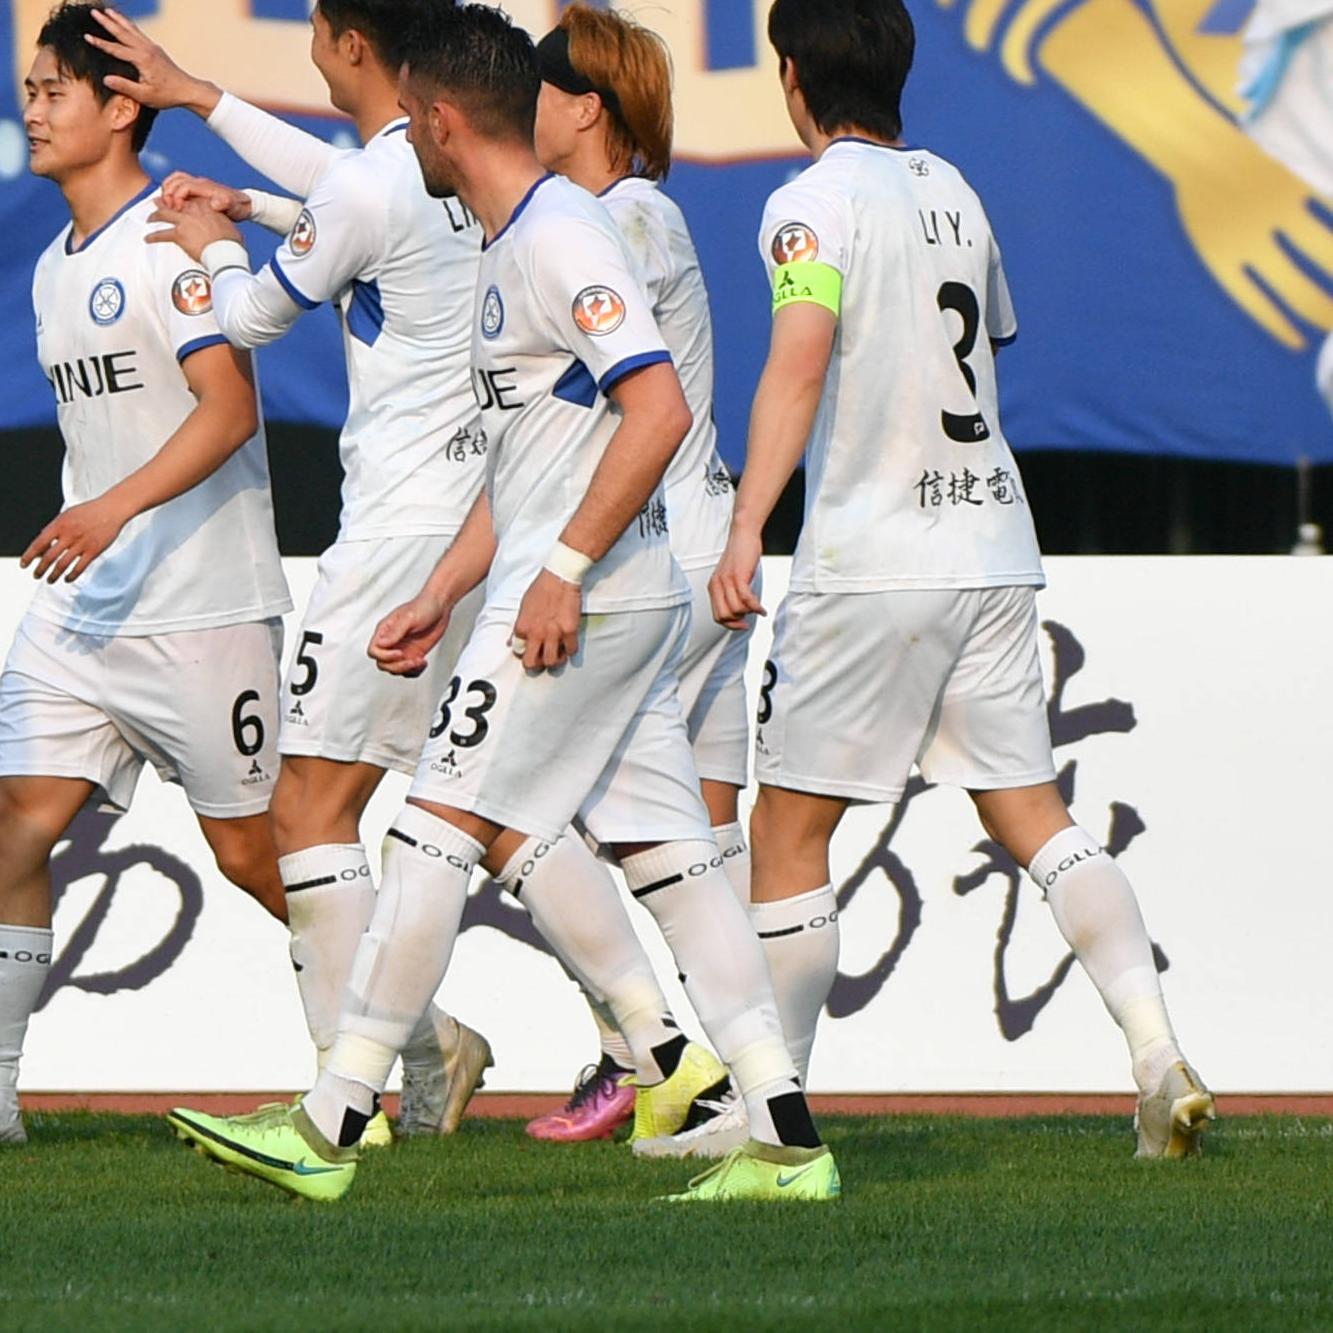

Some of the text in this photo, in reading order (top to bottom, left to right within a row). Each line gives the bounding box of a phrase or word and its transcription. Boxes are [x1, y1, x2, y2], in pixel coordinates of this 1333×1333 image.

[47, 350, 144, 404] INJE
[935, 281, 991, 444] 3
[232, 689, 265, 757] 6
